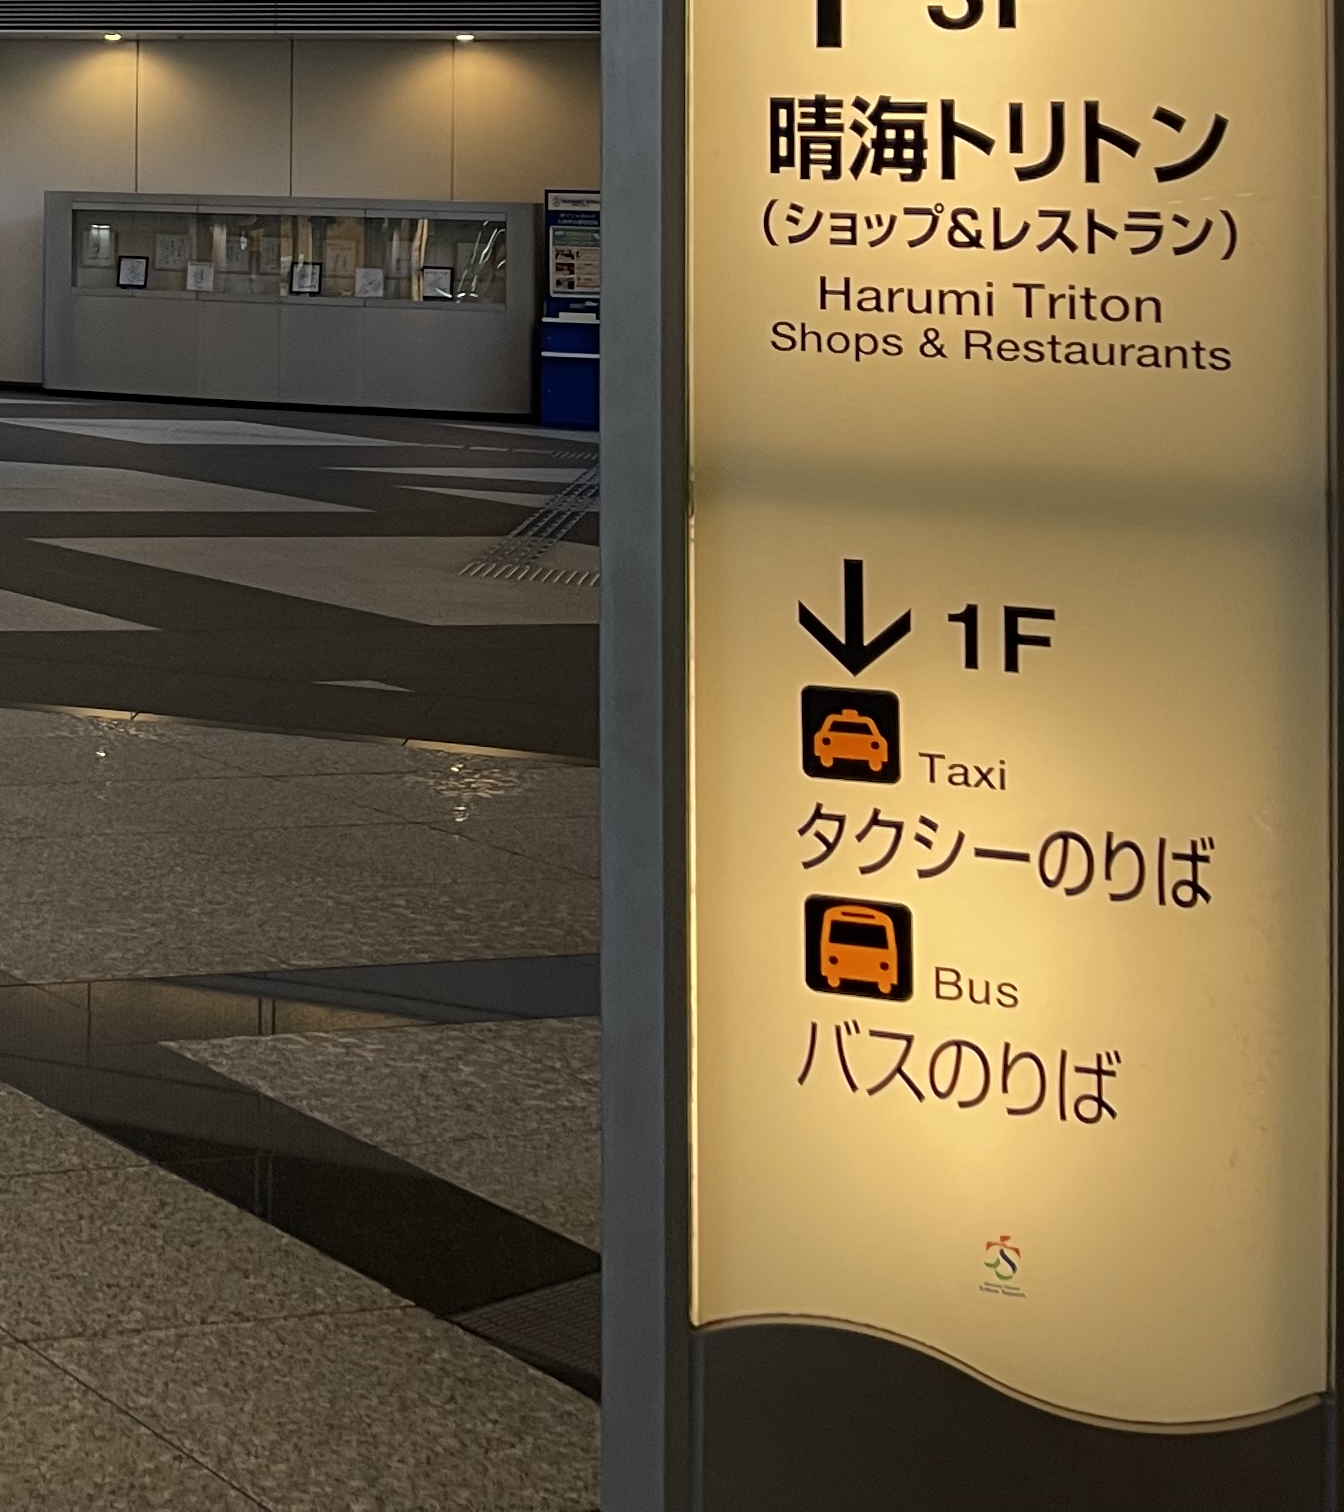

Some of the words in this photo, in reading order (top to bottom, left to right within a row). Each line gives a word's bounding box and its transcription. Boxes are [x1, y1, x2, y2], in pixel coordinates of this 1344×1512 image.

[768, 94, 1231, 185] 晴海トリトン
[818, 275, 996, 318] Harumi
[1011, 282, 1164, 325] Triton
[769, 320, 905, 363] Shops
[916, 328, 950, 360] &
[964, 329, 1233, 373] Restaurants
[946, 603, 1058, 674] 1F
[916, 751, 1009, 792] Taxi
[796, 801, 1216, 910] タクシーのりば
[933, 966, 1020, 1009] Bus
[796, 1018, 1124, 1126] バスのりば
